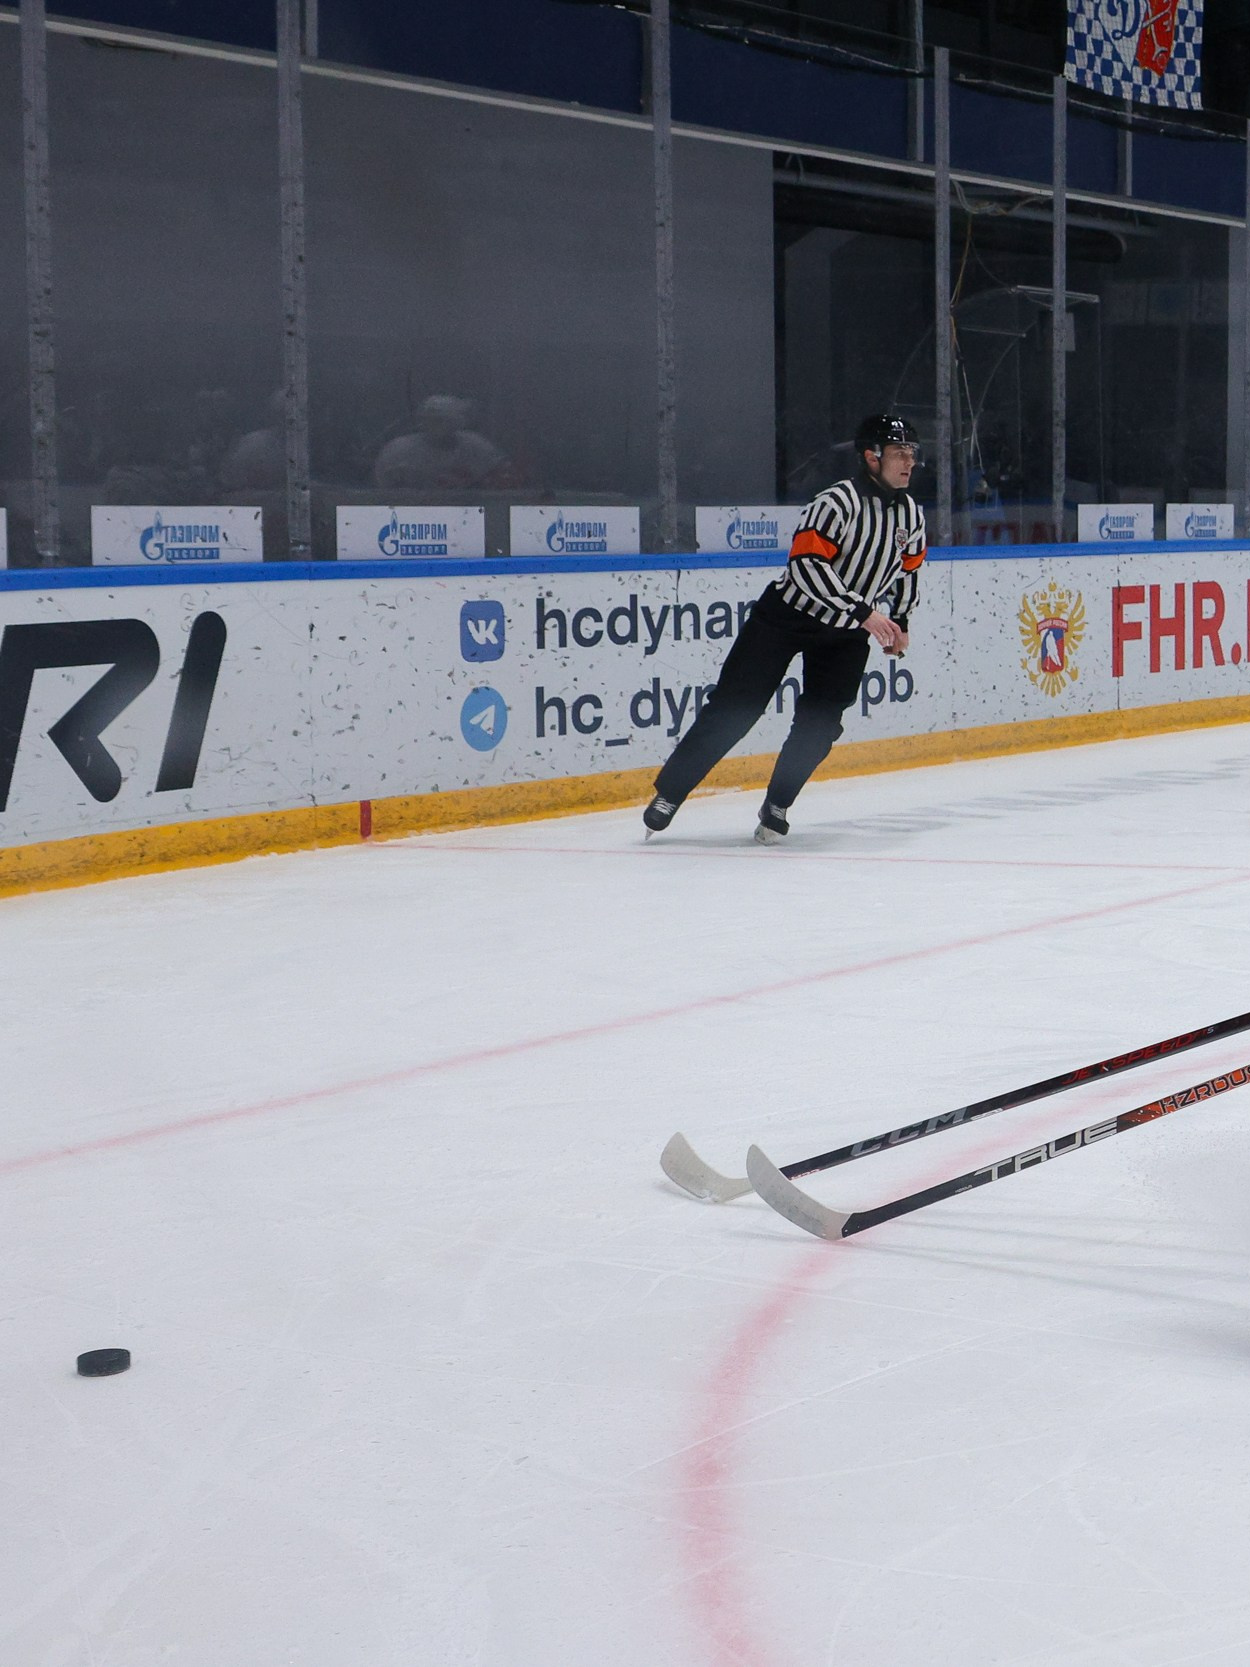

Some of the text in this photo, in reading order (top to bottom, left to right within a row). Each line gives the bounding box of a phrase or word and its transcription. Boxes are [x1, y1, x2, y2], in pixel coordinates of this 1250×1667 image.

[400, 523, 447, 540] ГАЗПРОМ
[565, 522, 607, 538] ГАЗПРОМ
[850, 1106, 968, 1157] CCM
[973, 1116, 1118, 1182] TRUE
